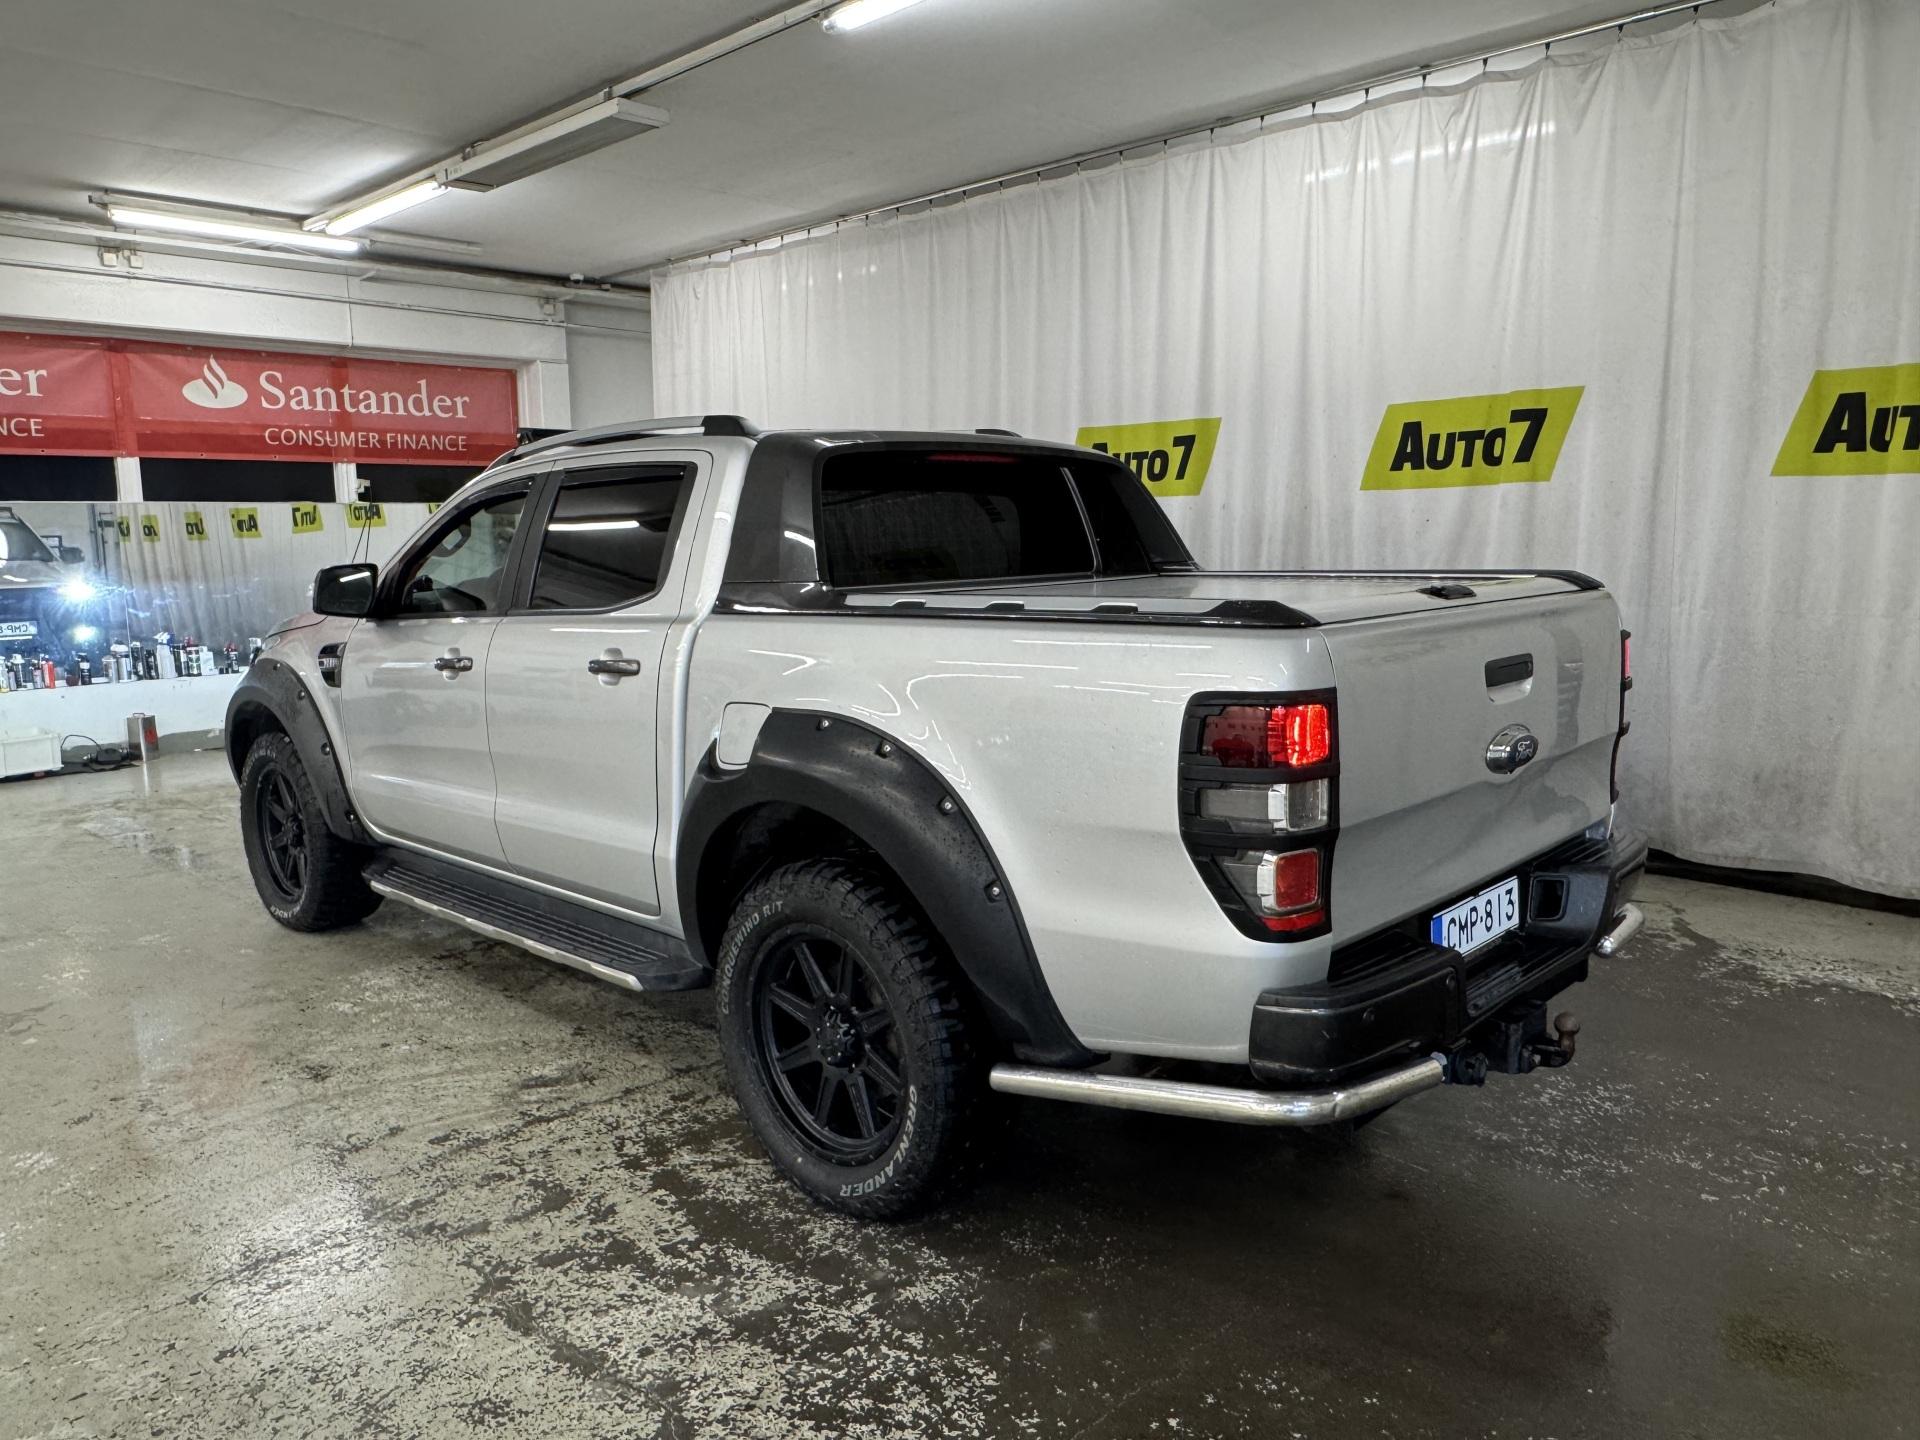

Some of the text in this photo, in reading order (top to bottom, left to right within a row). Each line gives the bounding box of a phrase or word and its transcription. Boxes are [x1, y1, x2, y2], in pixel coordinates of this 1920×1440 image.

[259, 370, 470, 419] Santander
[264, 427, 468, 452] CONSUMER FINANCE
[1447, 886, 1515, 949] CMP-813
[839, 1084, 918, 1197] GRENLANDER
